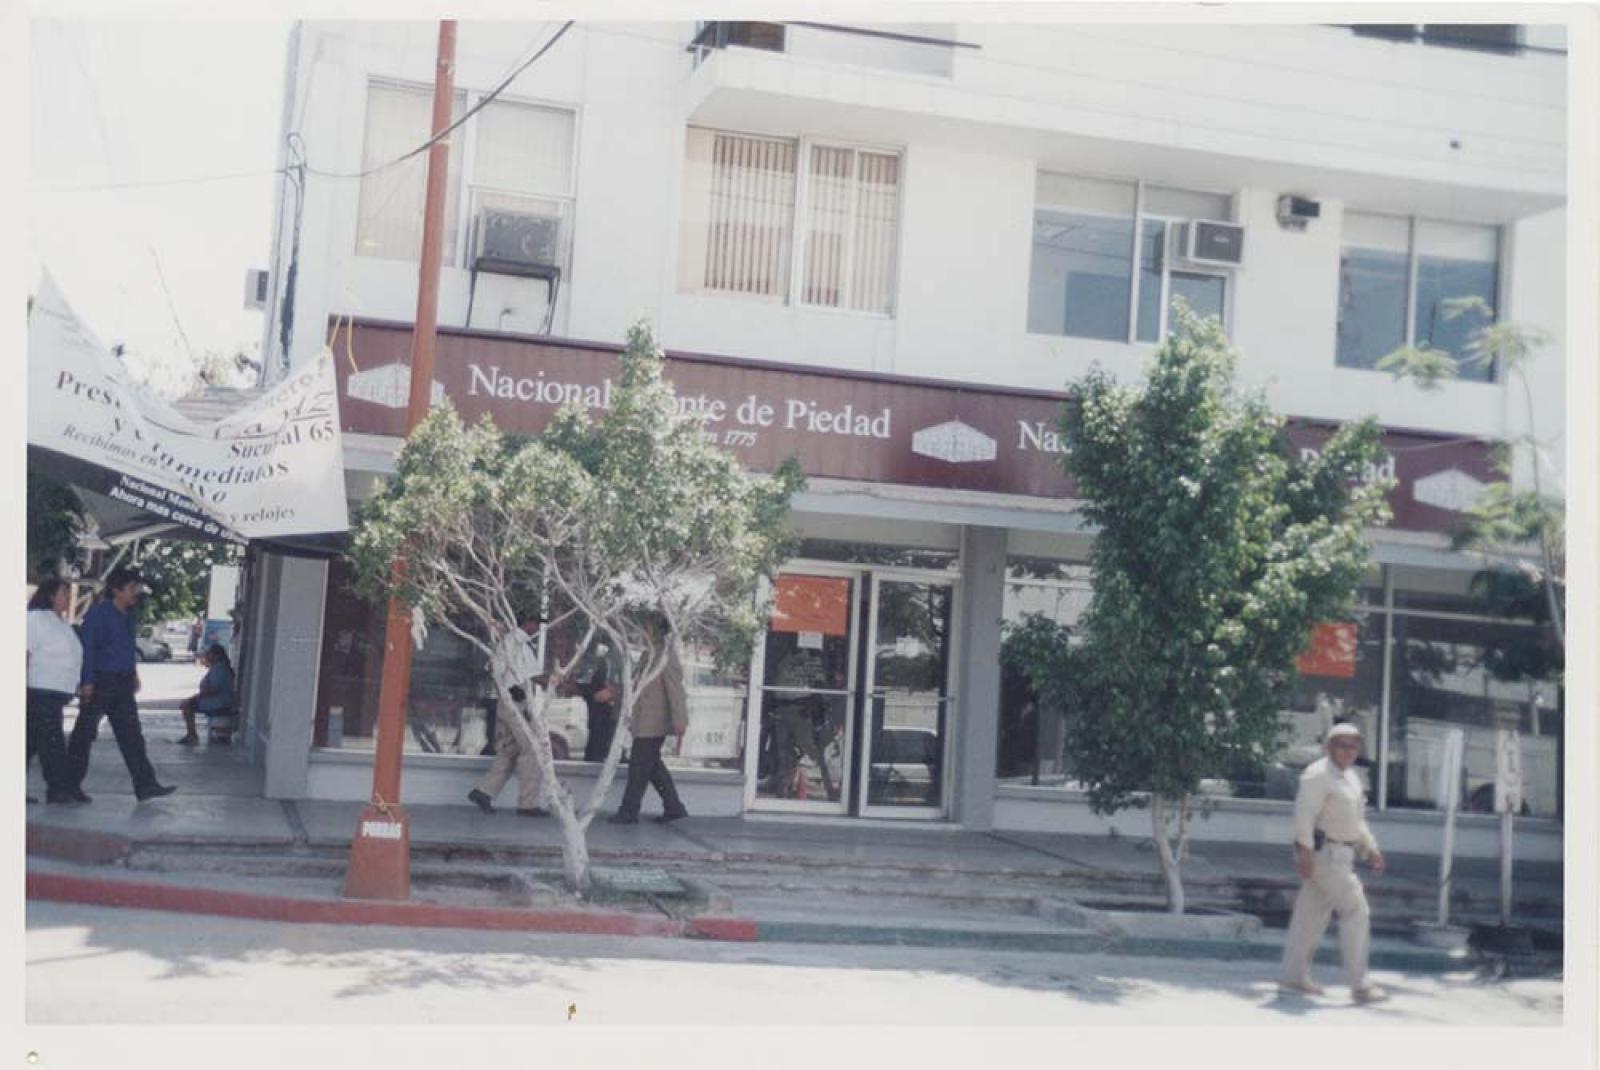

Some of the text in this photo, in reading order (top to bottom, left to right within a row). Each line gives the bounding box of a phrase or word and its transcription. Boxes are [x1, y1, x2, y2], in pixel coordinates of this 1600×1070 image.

[466, 362, 613, 409] Nacional
[736, 394, 776, 427] de
[784, 399, 892, 440] Piedad
[309, 420, 335, 442] 65
[241, 506, 295, 523] relojes
